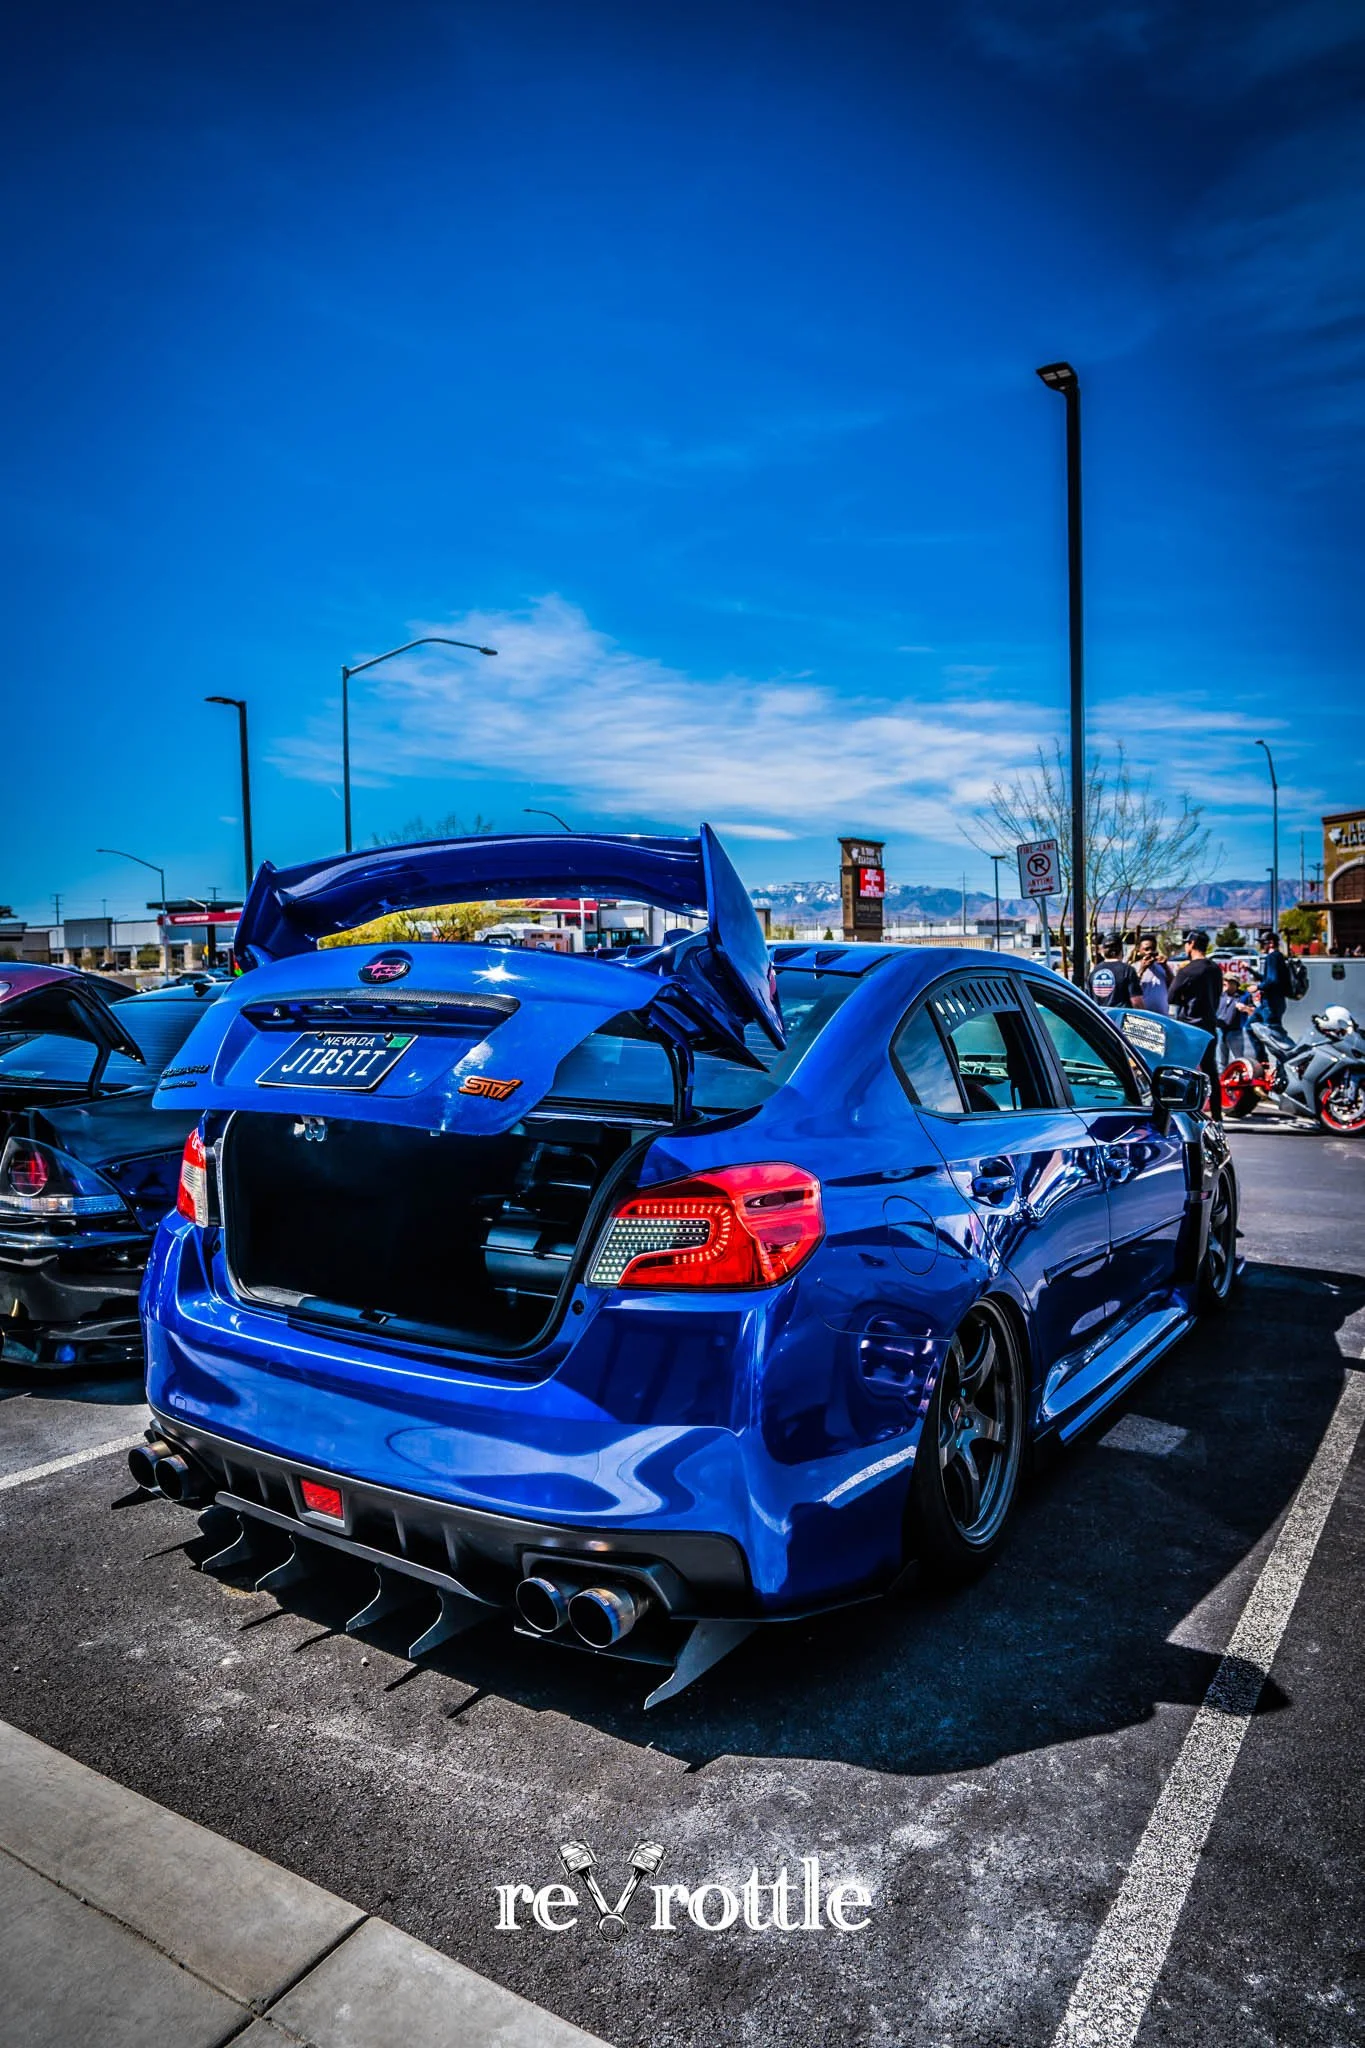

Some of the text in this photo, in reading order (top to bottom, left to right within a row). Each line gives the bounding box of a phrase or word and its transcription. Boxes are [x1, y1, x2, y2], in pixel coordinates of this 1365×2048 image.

[1038, 842, 1054, 852] LANE
[1027, 876, 1054, 888] ANYTIME
[323, 1036, 376, 1047] NEVADA
[281, 1047, 387, 1076] JTBSTI
